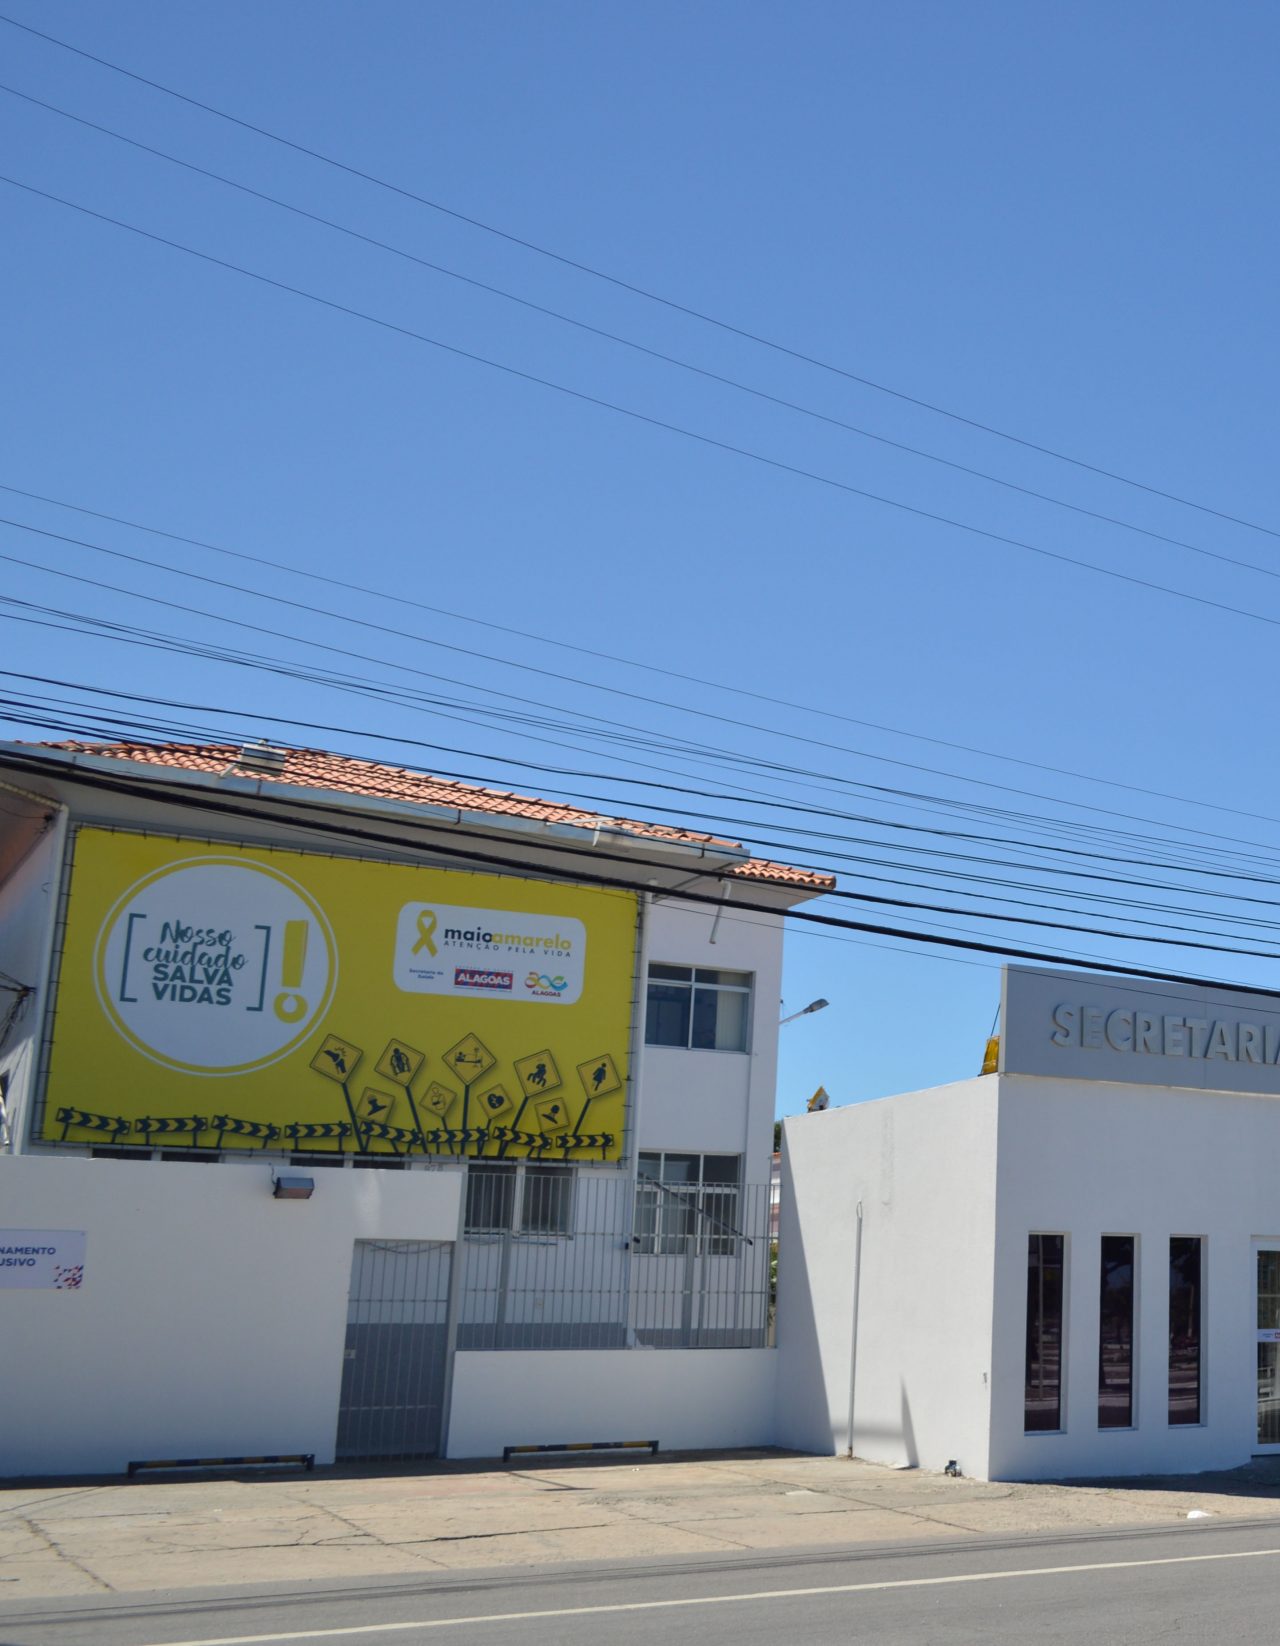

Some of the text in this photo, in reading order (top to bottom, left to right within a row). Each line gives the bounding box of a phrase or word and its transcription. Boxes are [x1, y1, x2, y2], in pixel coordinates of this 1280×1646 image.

[160, 919, 236, 946] Nosso
[143, 942, 248, 970] cuidado
[443, 940, 571, 958] ATENÇÃO PELA VIDA
[152, 963, 233, 986] SALVA
[457, 973, 511, 986] ALAGOAS
[152, 982, 231, 1005] VIDAS
